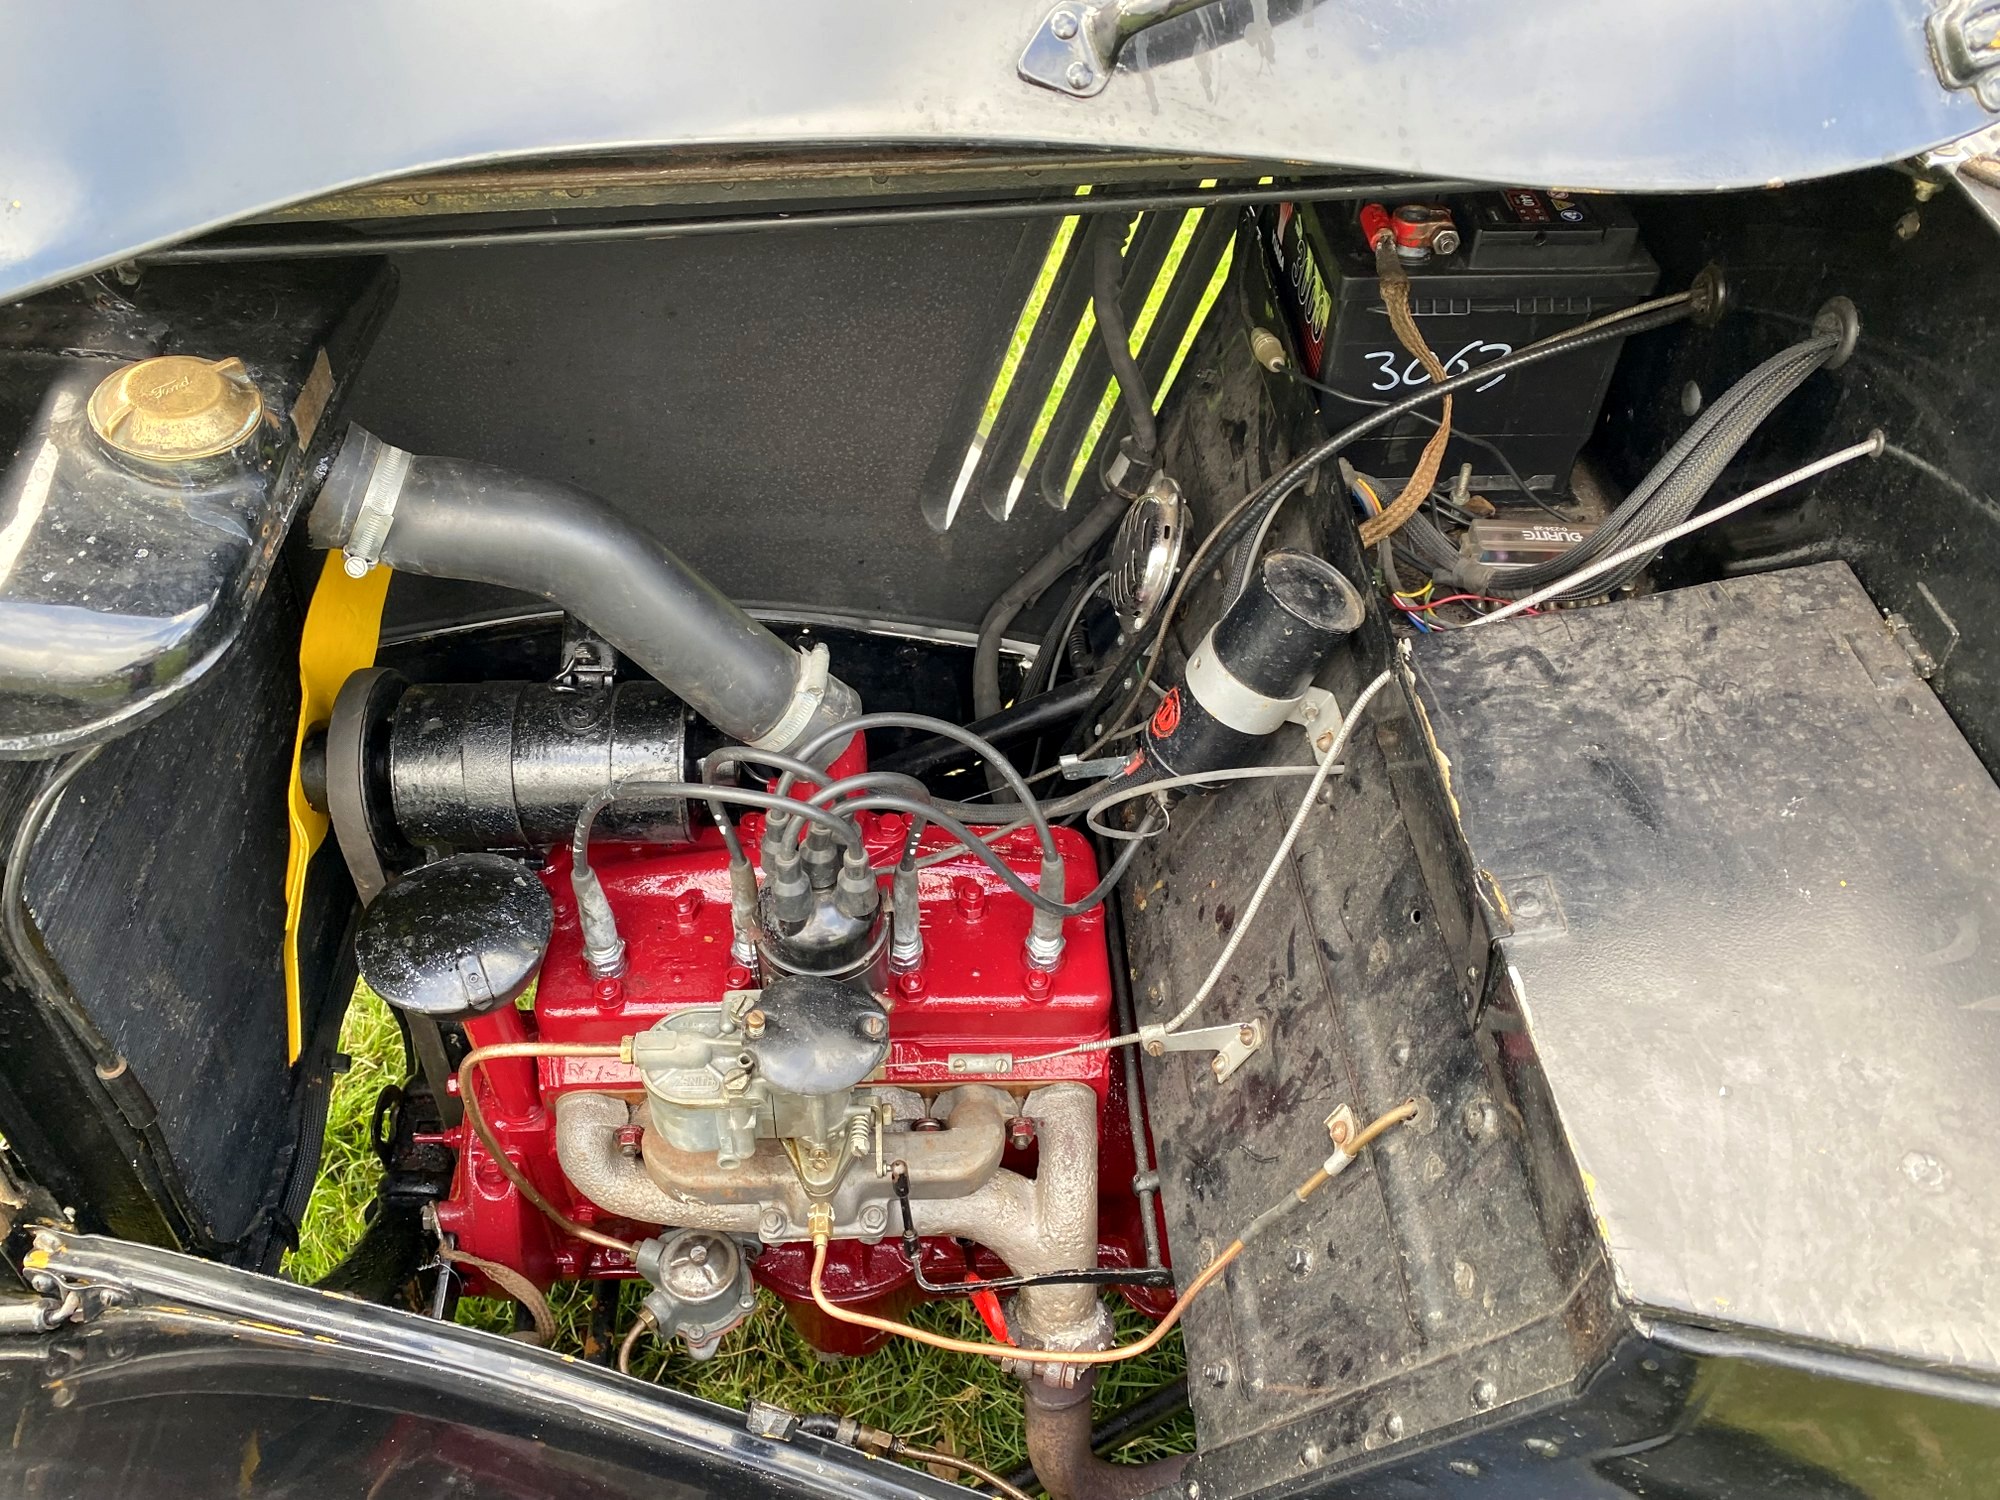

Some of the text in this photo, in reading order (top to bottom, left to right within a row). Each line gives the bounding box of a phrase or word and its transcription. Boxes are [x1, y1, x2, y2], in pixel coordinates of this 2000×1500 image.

[1291, 239, 1325, 343] 3000
[151, 375, 193, 399] Ford
[1522, 530, 1584, 542] DURITE
